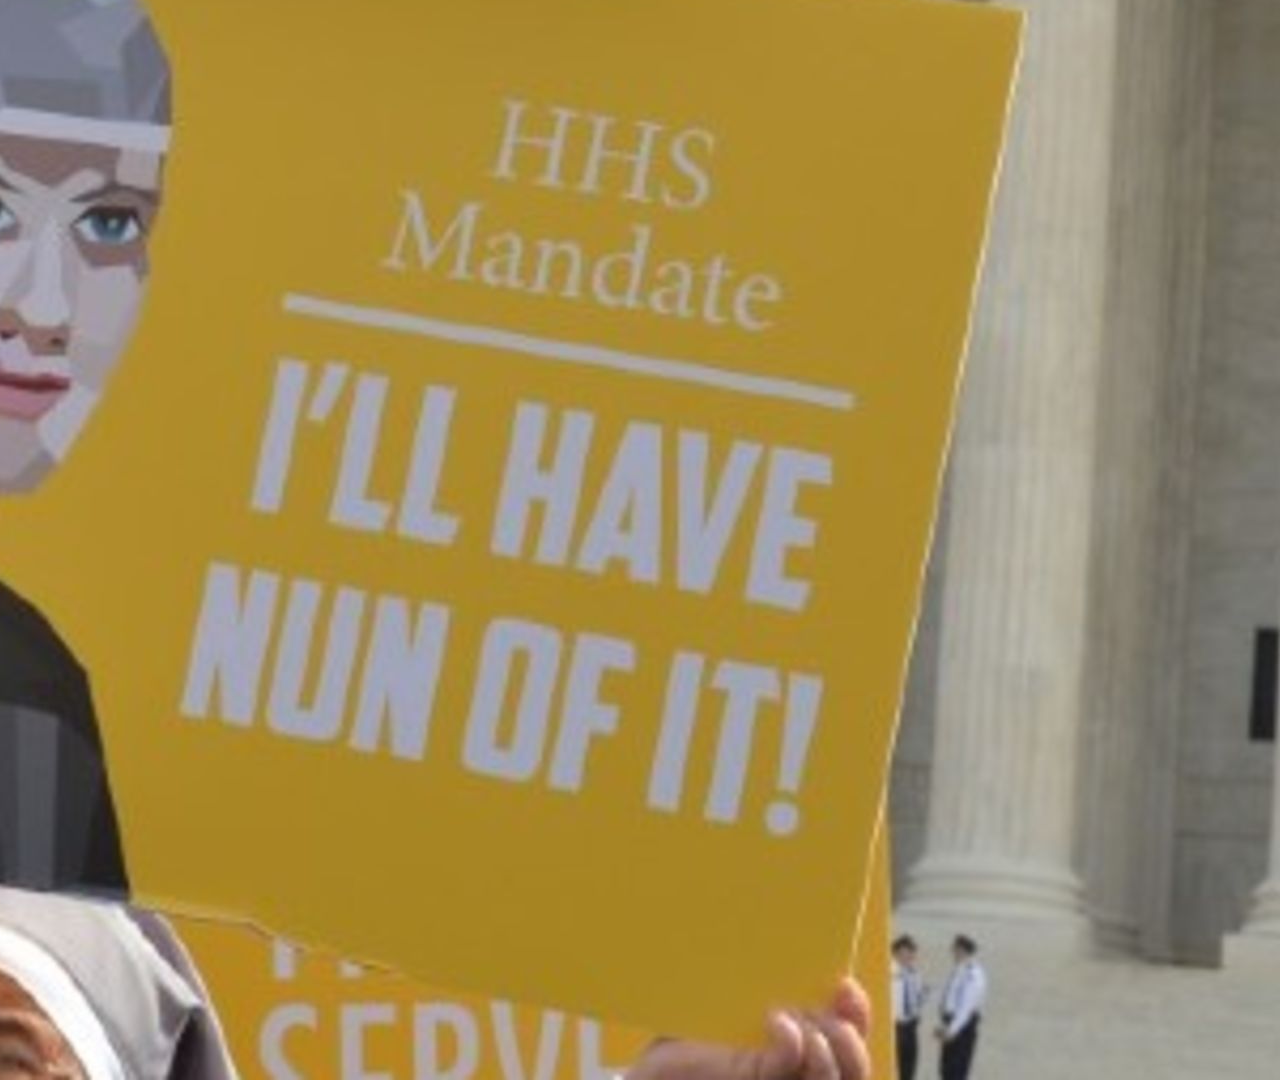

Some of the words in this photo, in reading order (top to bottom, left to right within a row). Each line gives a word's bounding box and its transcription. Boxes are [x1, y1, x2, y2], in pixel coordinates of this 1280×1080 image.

[491, 96, 714, 210] HHS
[381, 190, 784, 332] Mandate
[490, 401, 833, 611] HAVE
[181, 561, 452, 760] NUN
[461, 616, 639, 792] OF
[646, 649, 824, 836] IT!
